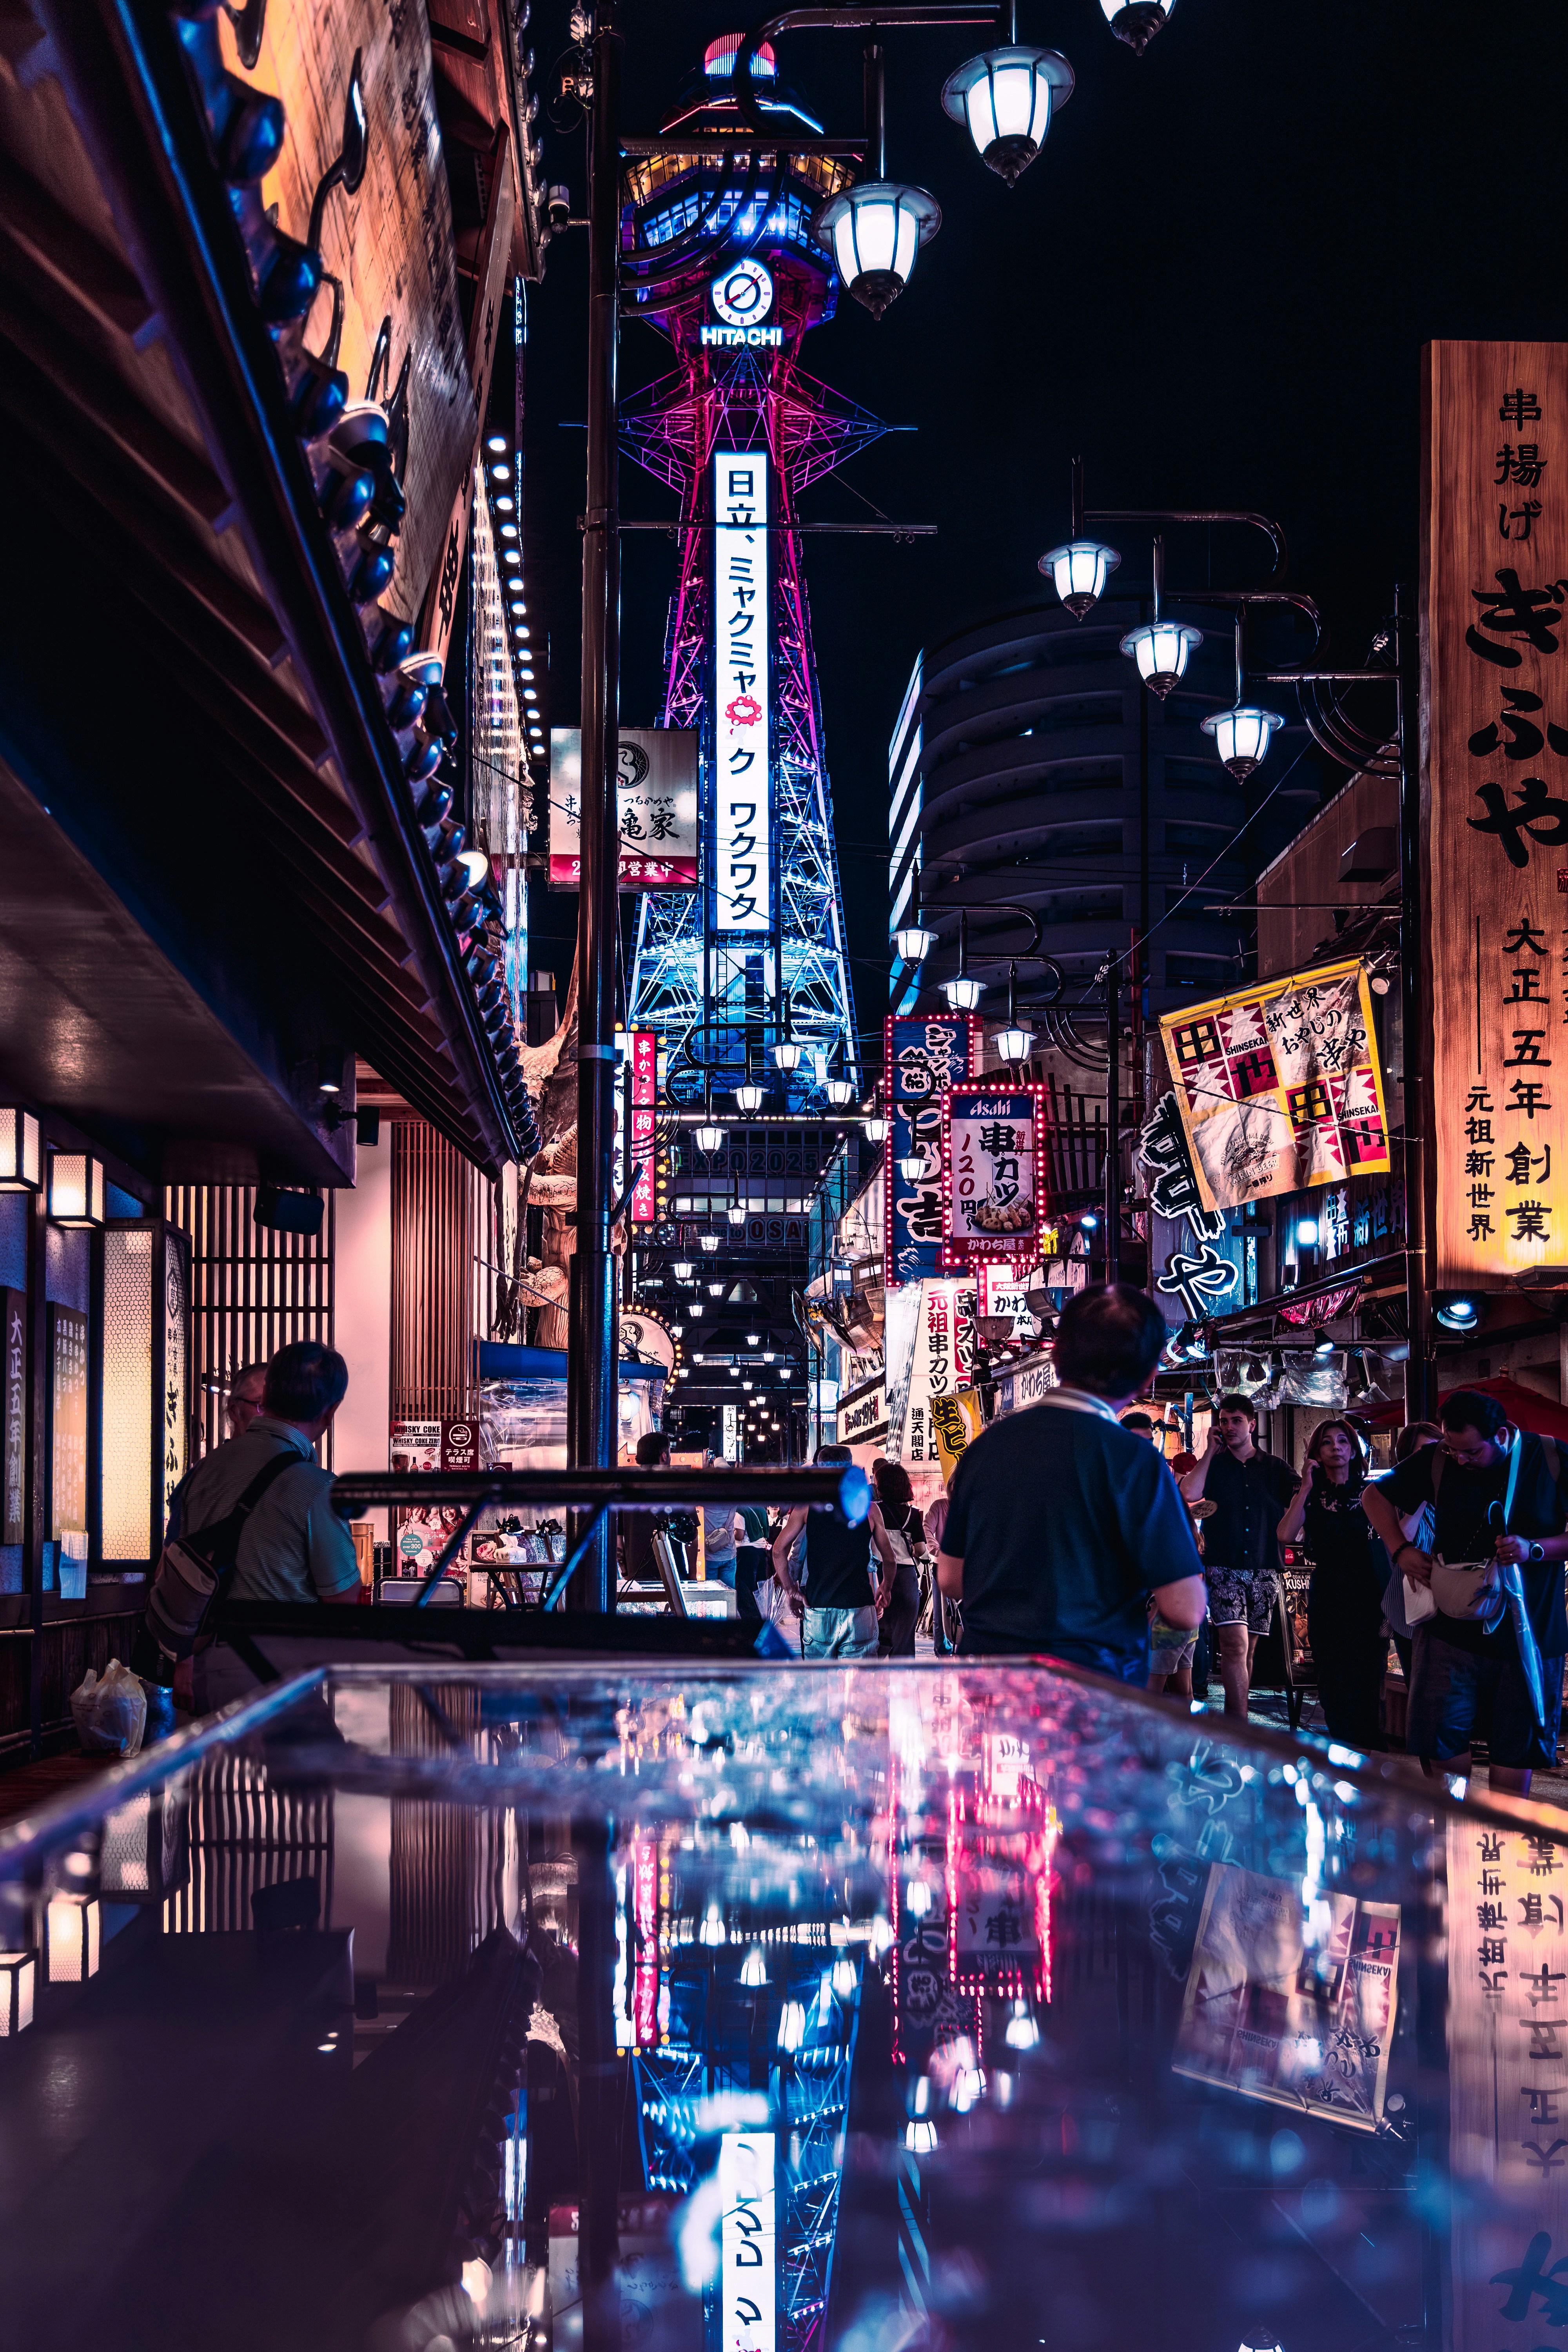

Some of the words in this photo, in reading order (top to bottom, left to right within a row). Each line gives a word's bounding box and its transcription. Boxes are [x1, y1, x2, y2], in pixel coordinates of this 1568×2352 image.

[702, 329, 782, 345] HITACHI
[1494, 388, 1547, 540] 串揚げ
[1465, 568, 1568, 868] ぎふや
[623, 795, 673, 807] つるかめや
[621, 808, 680, 840] 亀家
[572, 861, 673, 877] 2営業中
[1265, 987, 1326, 1033] 新世界
[1282, 1010, 1342, 1055] おやじの
[1502, 918, 1552, 1242] 大正五年創業
[970, 1100, 1011, 1116] Asahi
[1014, 1130, 1025, 1156] 新世界
[978, 1121, 1019, 1208] 串カツ
[1233, 1167, 1256, 1184] KIRIN
[1256, 1159, 1277, 1174] BEER
[1465, 1086, 1495, 1241] 元祖新世界
[1245, 1173, 1273, 1189] 一番搾り
[751, 1220, 802, 1239] OSA
[1354, 1179, 1406, 1248] 新世界
[967, 1238, 1016, 1250] かわち屋
[1018, 1239, 1024, 1250] 本店
[993, 1295, 1027, 1312] かわ
[1021, 1363, 1051, 1400] かわち屋
[911, 1408, 924, 1461] 通天閣店
[933, 1397, 969, 1463] 生ビ
[1286, 1579, 1310, 1590] KUSHI
